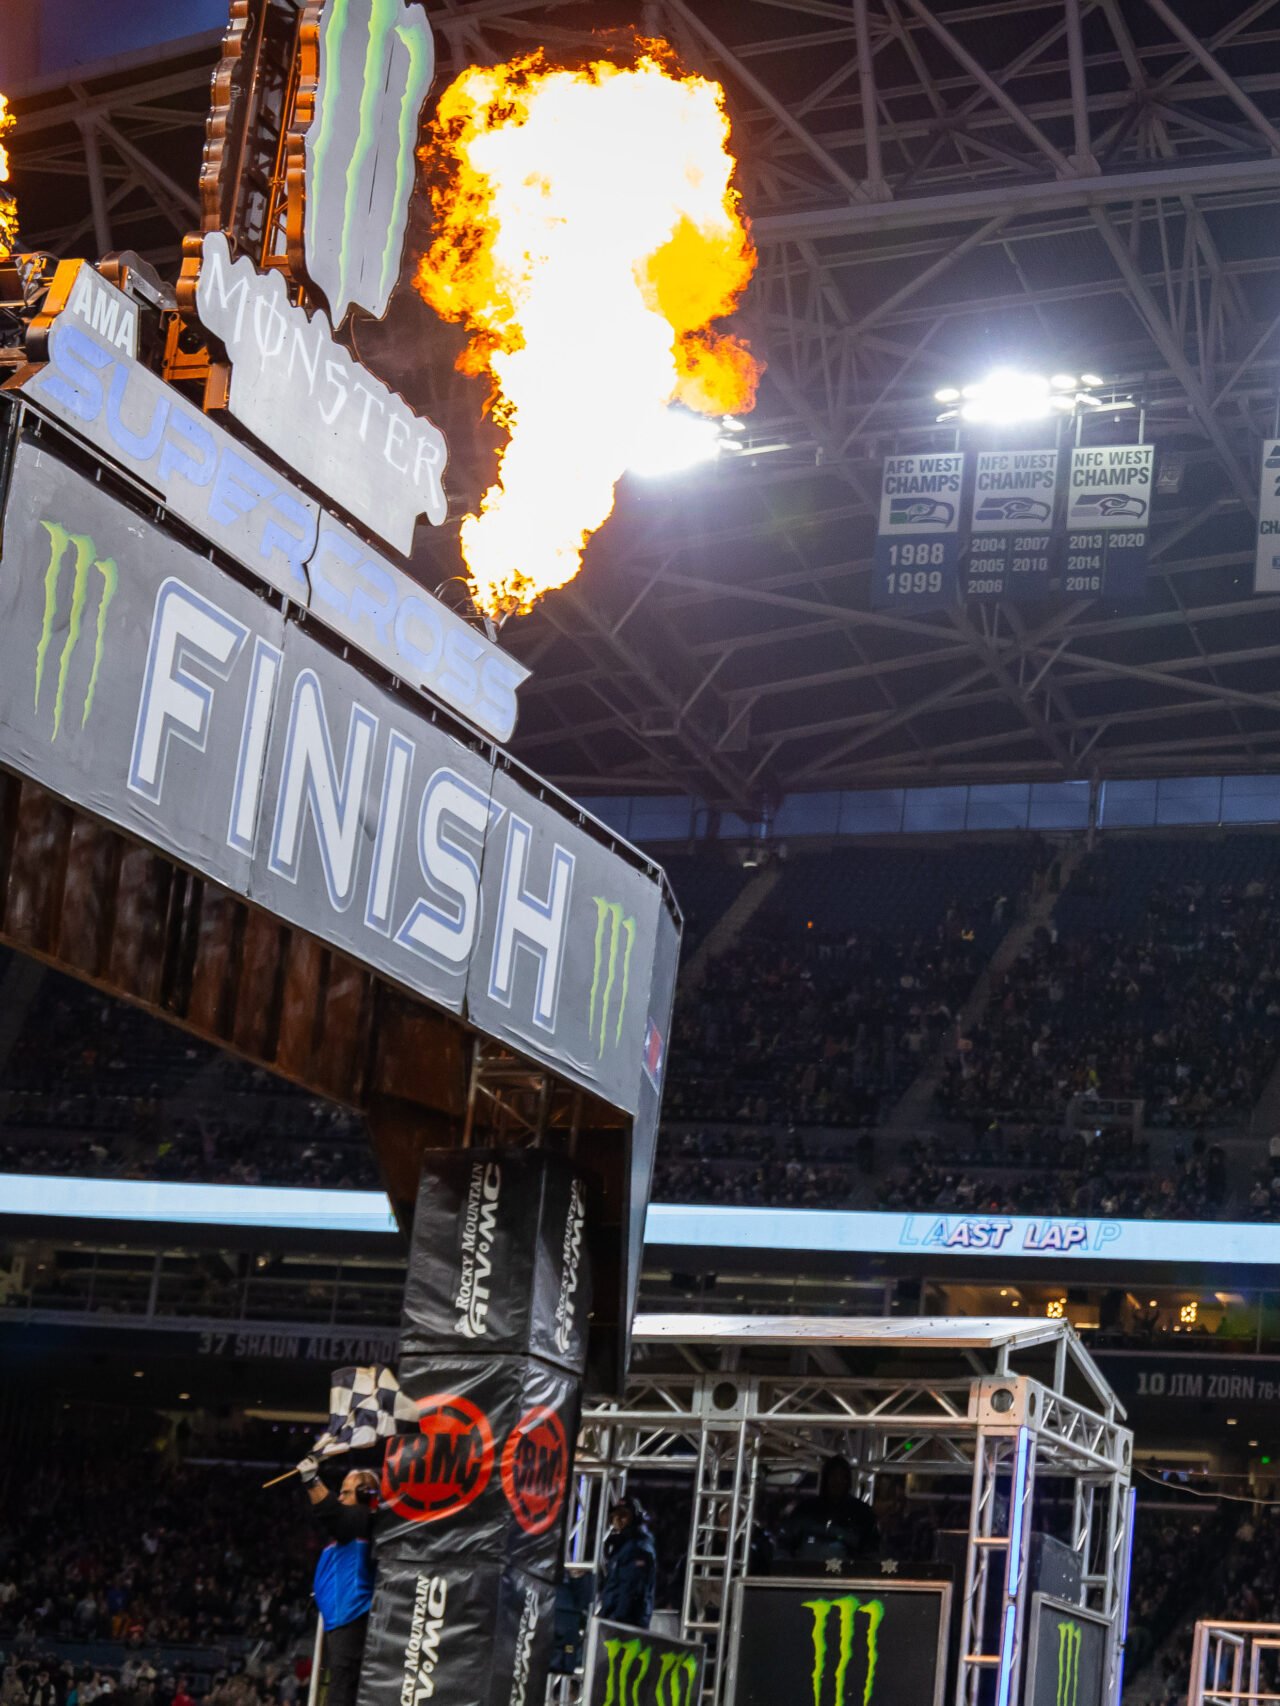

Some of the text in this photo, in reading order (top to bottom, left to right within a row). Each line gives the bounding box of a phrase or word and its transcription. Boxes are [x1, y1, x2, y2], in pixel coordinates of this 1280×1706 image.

[72, 276, 136, 356] AMA
[886, 457, 961, 474] AFC WEST
[980, 454, 1056, 470] NFC WEST
[1074, 450, 1152, 467] NFC WEST
[885, 474, 960, 495] CHAMPS
[978, 471, 1054, 491] CHAMPS
[1073, 467, 1149, 487] CHAMPS
[41, 325, 522, 742] SUPERCROSS
[1070, 533, 1145, 549] 2013 2020
[889, 543, 944, 566] 1988
[972, 537, 1049, 552] 2004 2007
[970, 558, 1047, 573] 2005 2010
[1068, 556, 1100, 570] 2014
[886, 571, 942, 594] 1999
[1066, 577, 1099, 591] 2016
[128, 576, 575, 1033] FINISH
[455, 1161, 483, 1311] ROCKY MOUNTAIN
[555, 1266, 569, 1322] ROCKY
[199, 1333, 228, 1355] 37
[234, 1334, 299, 1359] SHAUN
[1137, 1373, 1165, 1396] 10
[1167, 1374, 1203, 1398] JIM
[1207, 1374, 1255, 1400] ZORN
[404, 1575, 430, 1672] MOUNTAIN
